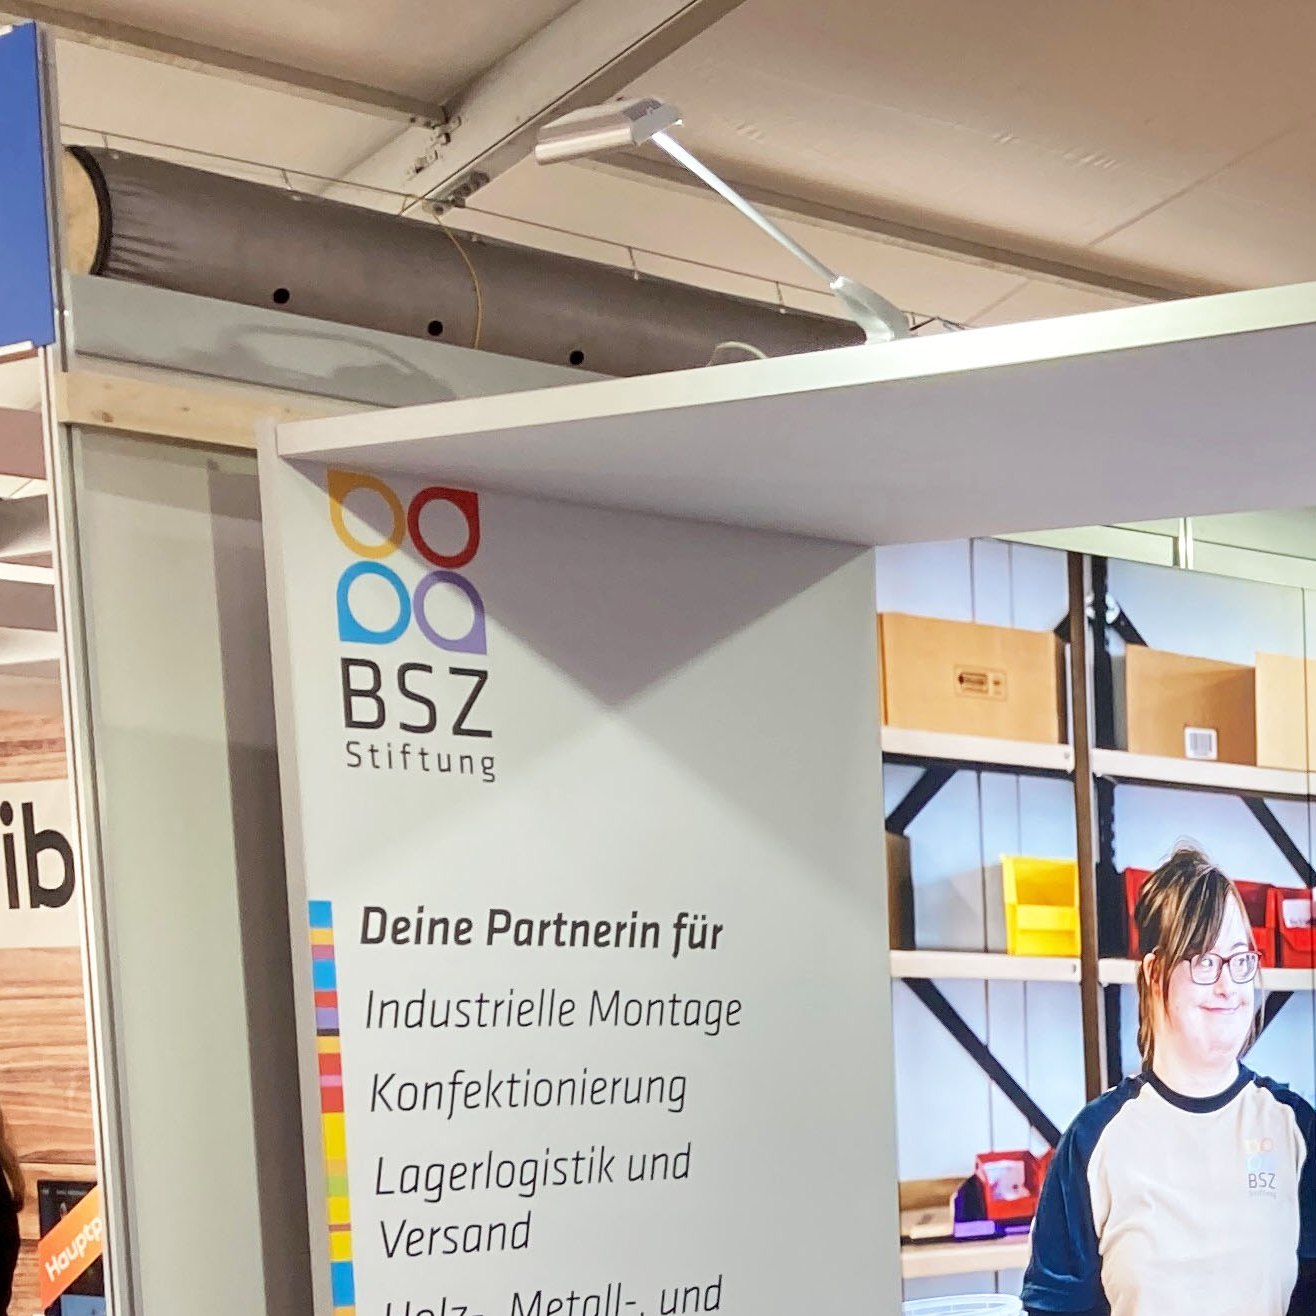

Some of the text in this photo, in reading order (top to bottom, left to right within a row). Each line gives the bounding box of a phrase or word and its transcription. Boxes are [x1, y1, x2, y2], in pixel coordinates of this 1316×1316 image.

[340, 657, 493, 738] BSZ
[345, 740, 496, 783] Stiftung
[0, 800, 76, 909] ib
[360, 906, 724, 958] Deine Partnerin für
[365, 988, 742, 1036] Industrielle Montage
[370, 1068, 687, 1120] Konfektionierung
[375, 1142, 692, 1203] Lagerlogistik und
[1248, 1171, 1276, 1190] BSZ
[380, 1211, 532, 1258] Versand
[660, 1274, 723, 1316] und
